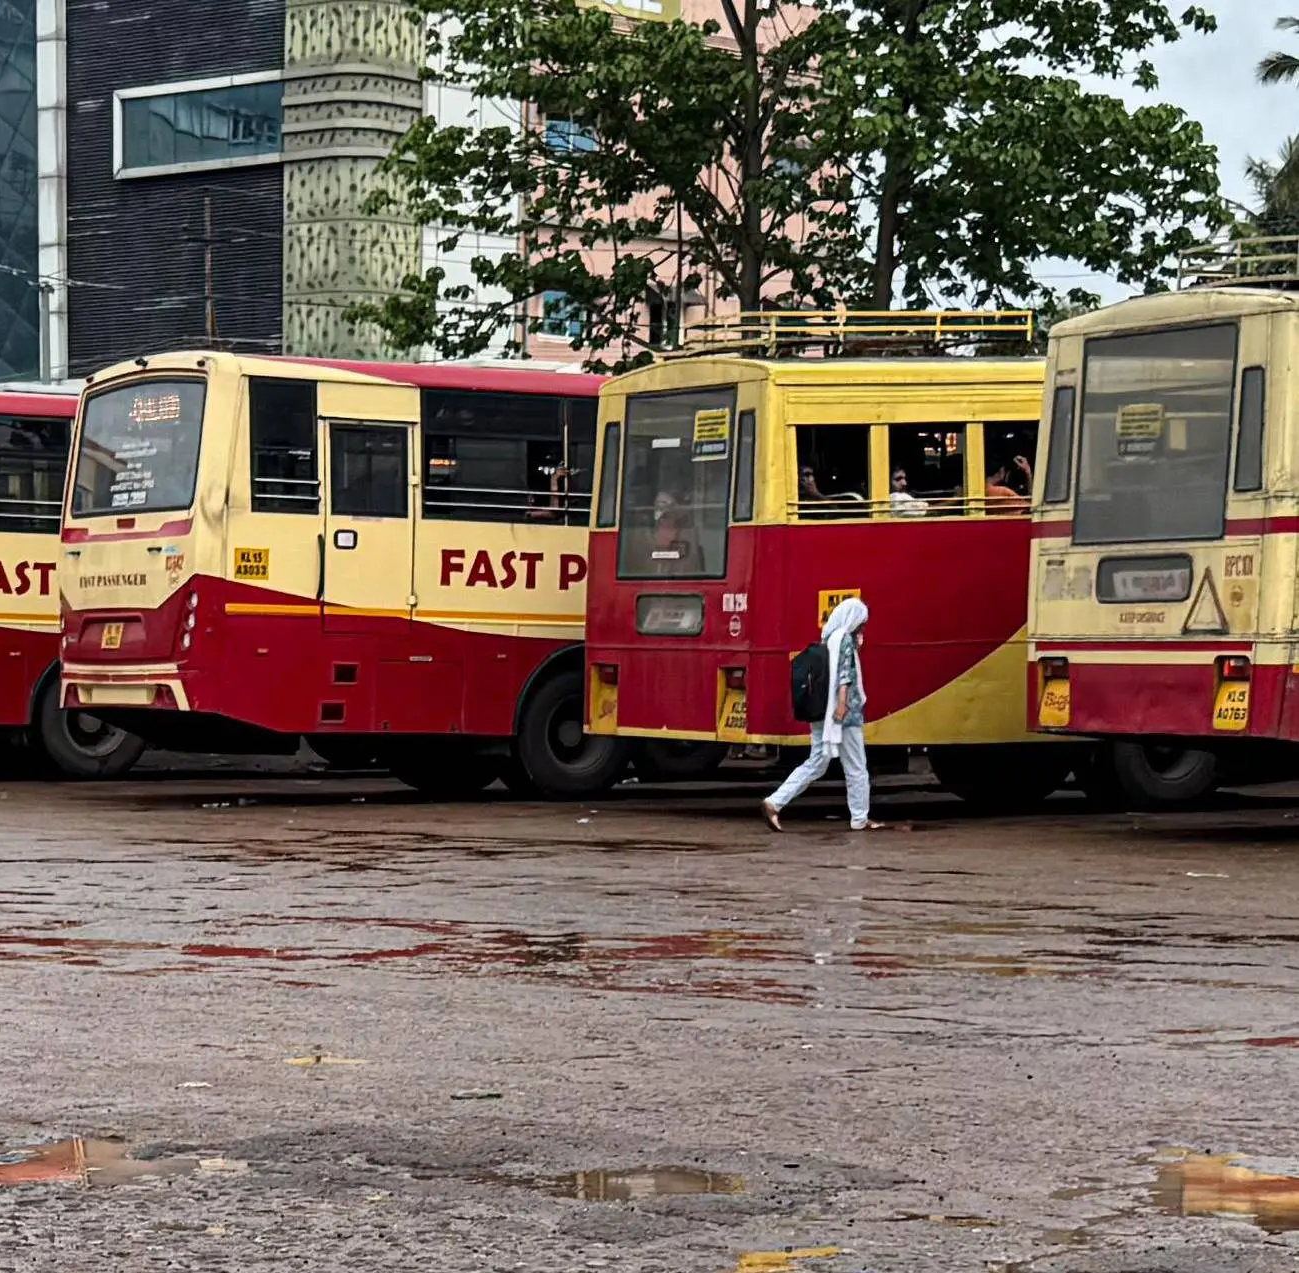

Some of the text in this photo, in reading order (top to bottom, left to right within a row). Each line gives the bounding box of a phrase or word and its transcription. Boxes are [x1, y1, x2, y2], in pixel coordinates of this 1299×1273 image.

[97, 574, 147, 588] PASSENGER
[441, 549, 588, 590] FAST P
